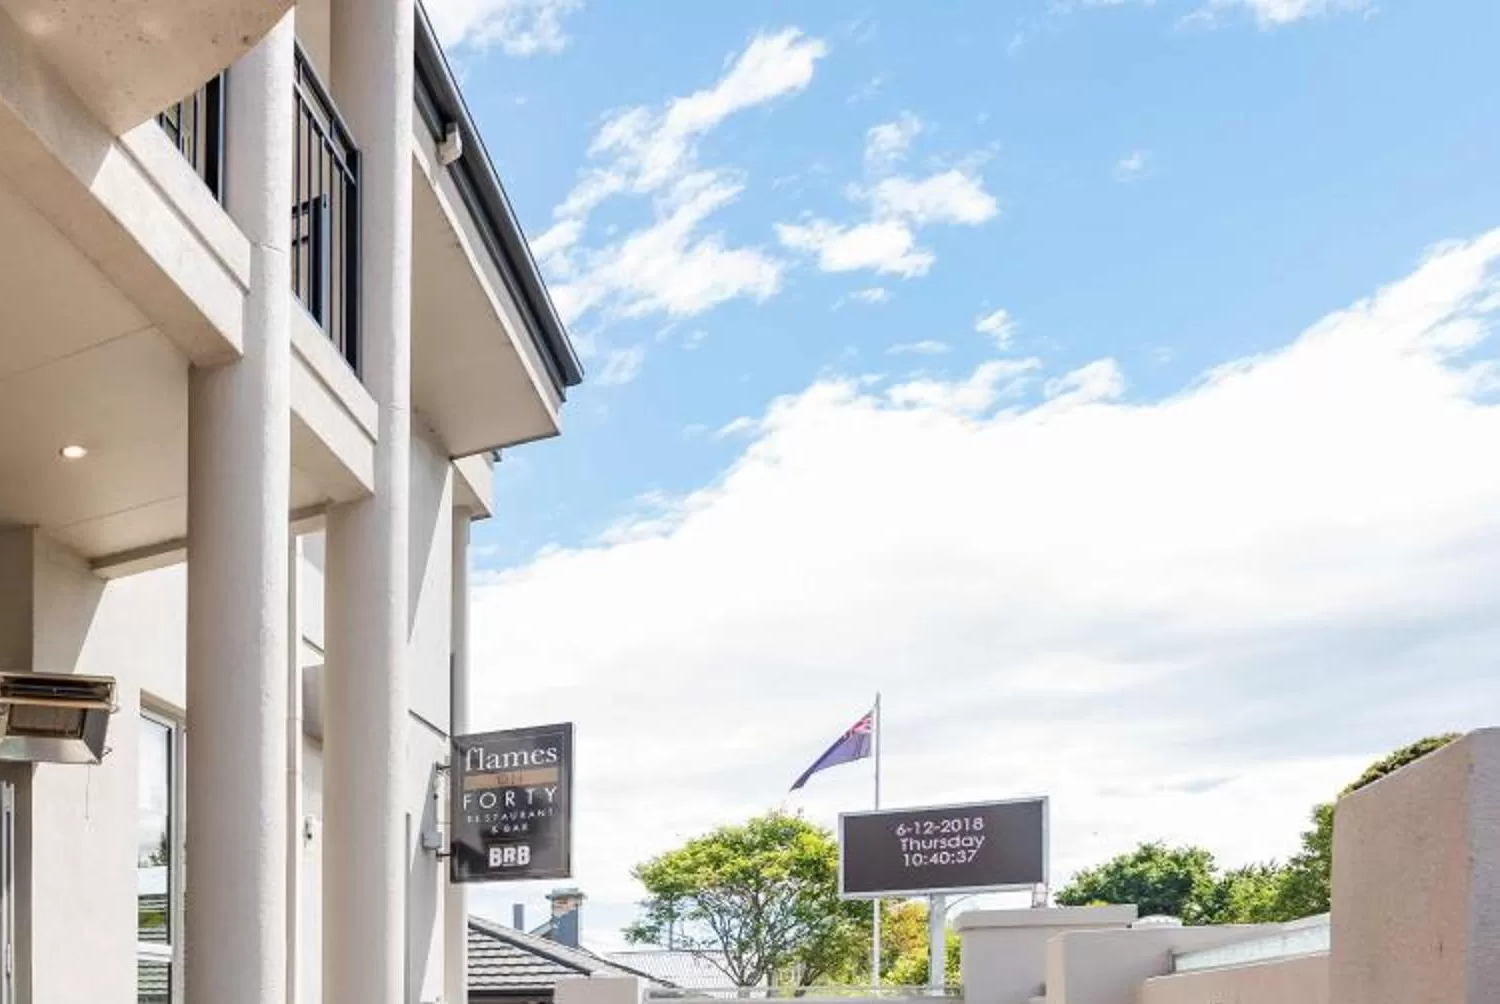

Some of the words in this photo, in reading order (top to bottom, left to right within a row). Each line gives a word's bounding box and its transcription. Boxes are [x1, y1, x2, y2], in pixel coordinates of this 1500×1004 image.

[465, 745, 558, 772] flames
[463, 786, 557, 811] FORTY
[467, 808, 553, 824] RESTAURANT
[895, 817, 985, 837] 6-12-2018
[900, 835, 986, 851] Thursday
[903, 849, 977, 868] 10:40:37
